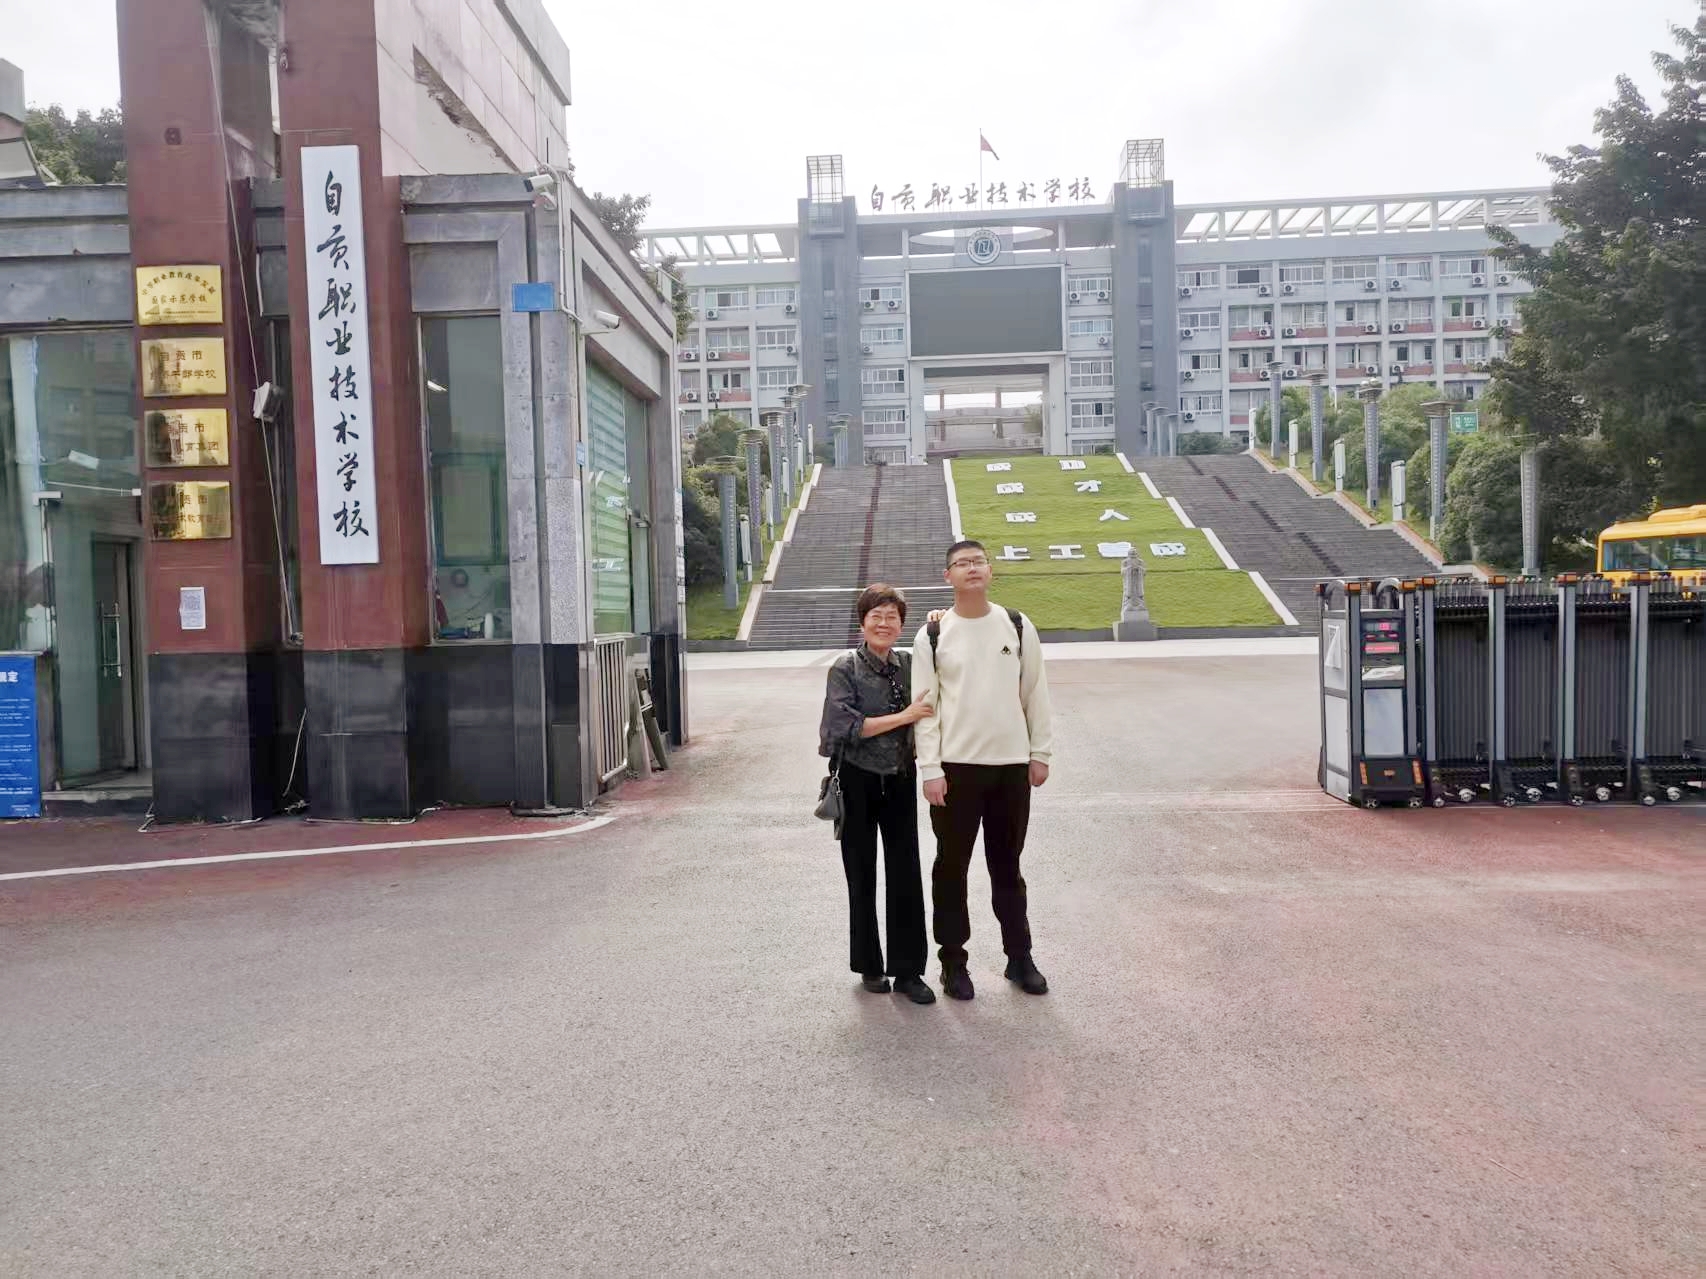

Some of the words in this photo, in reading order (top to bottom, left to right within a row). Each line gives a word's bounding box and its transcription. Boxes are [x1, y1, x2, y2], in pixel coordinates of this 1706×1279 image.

[870, 176, 1096, 212] 自贡职业技术学校
[316, 170, 370, 538] 自贡职业技术学校
